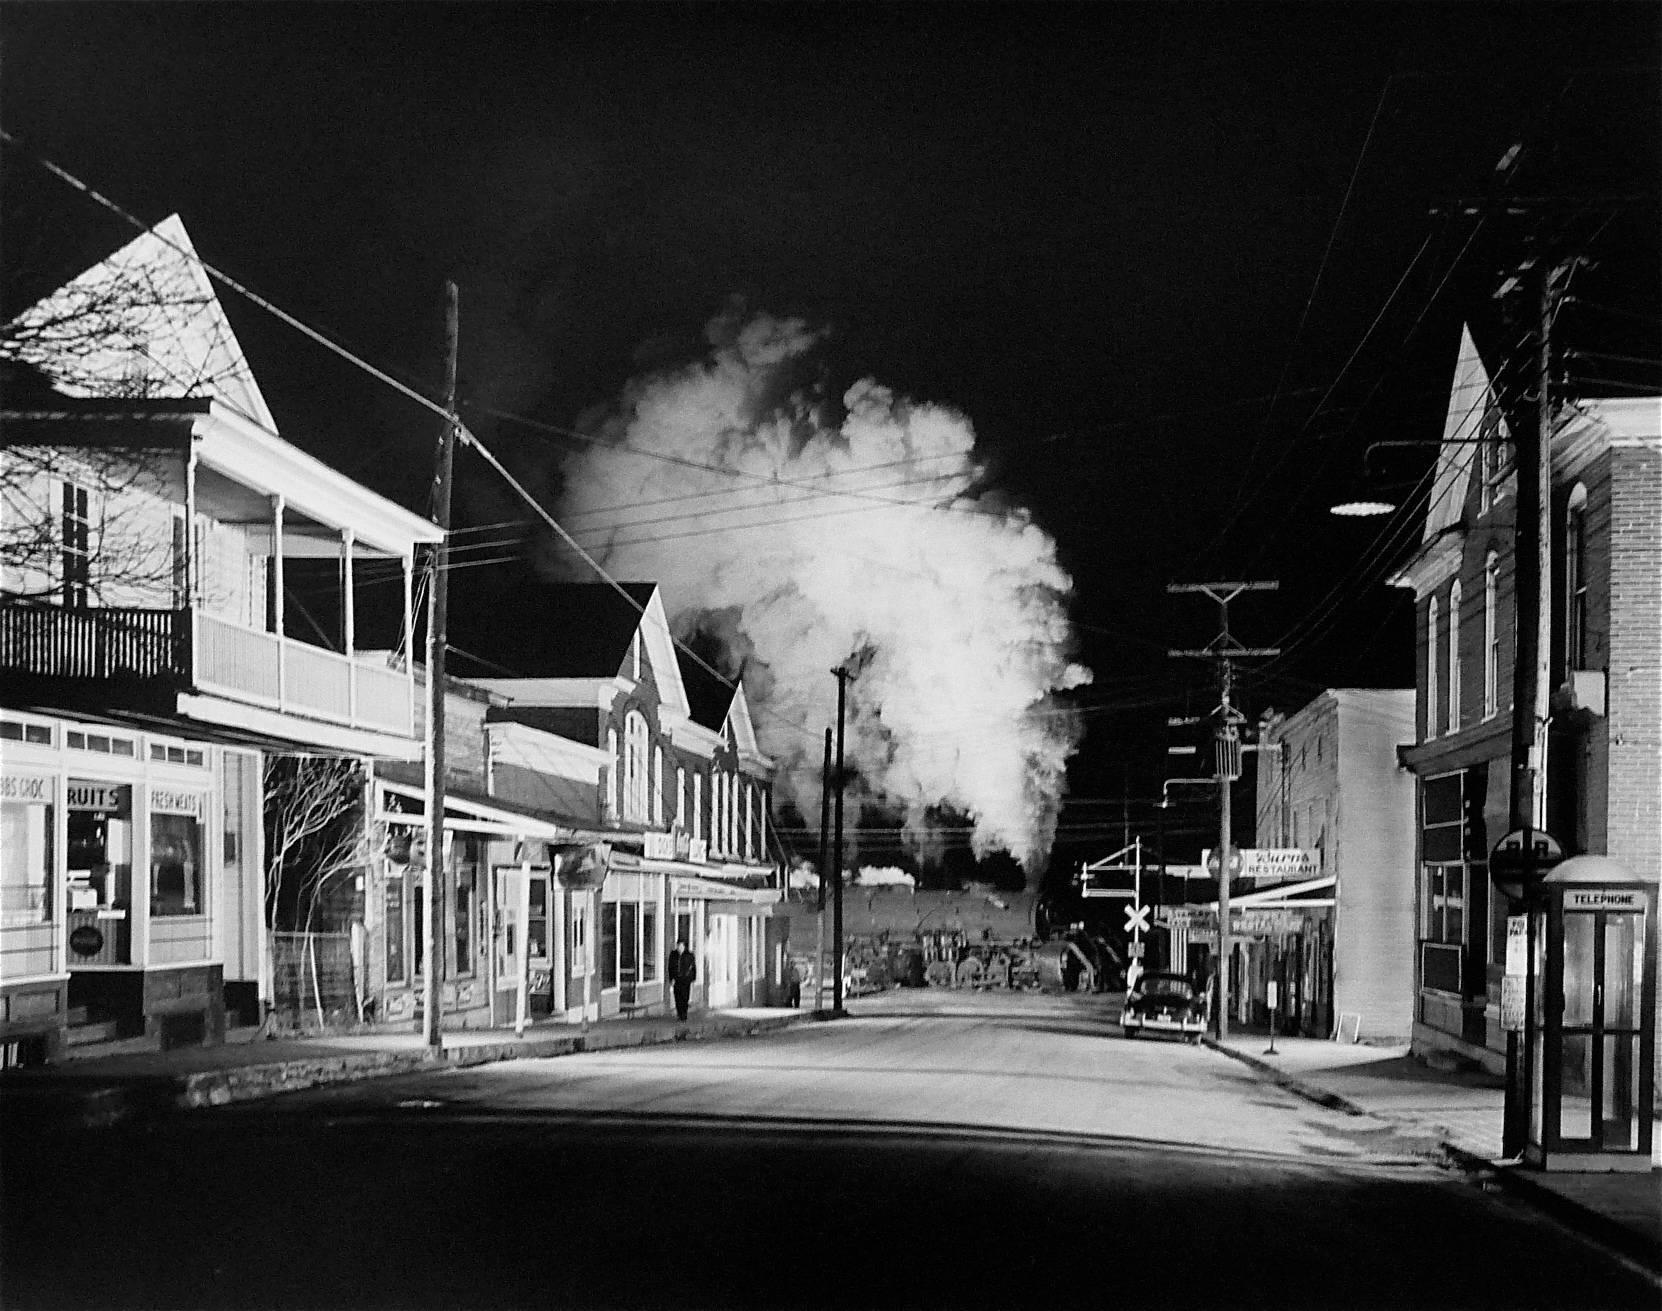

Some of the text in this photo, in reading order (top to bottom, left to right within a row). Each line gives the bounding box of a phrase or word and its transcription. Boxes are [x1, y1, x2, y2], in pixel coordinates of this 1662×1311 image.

[67, 787, 119, 806] RUITS
[1248, 865, 1317, 874] RESTAURANT
[1574, 894, 1634, 905] TELEPHONE
